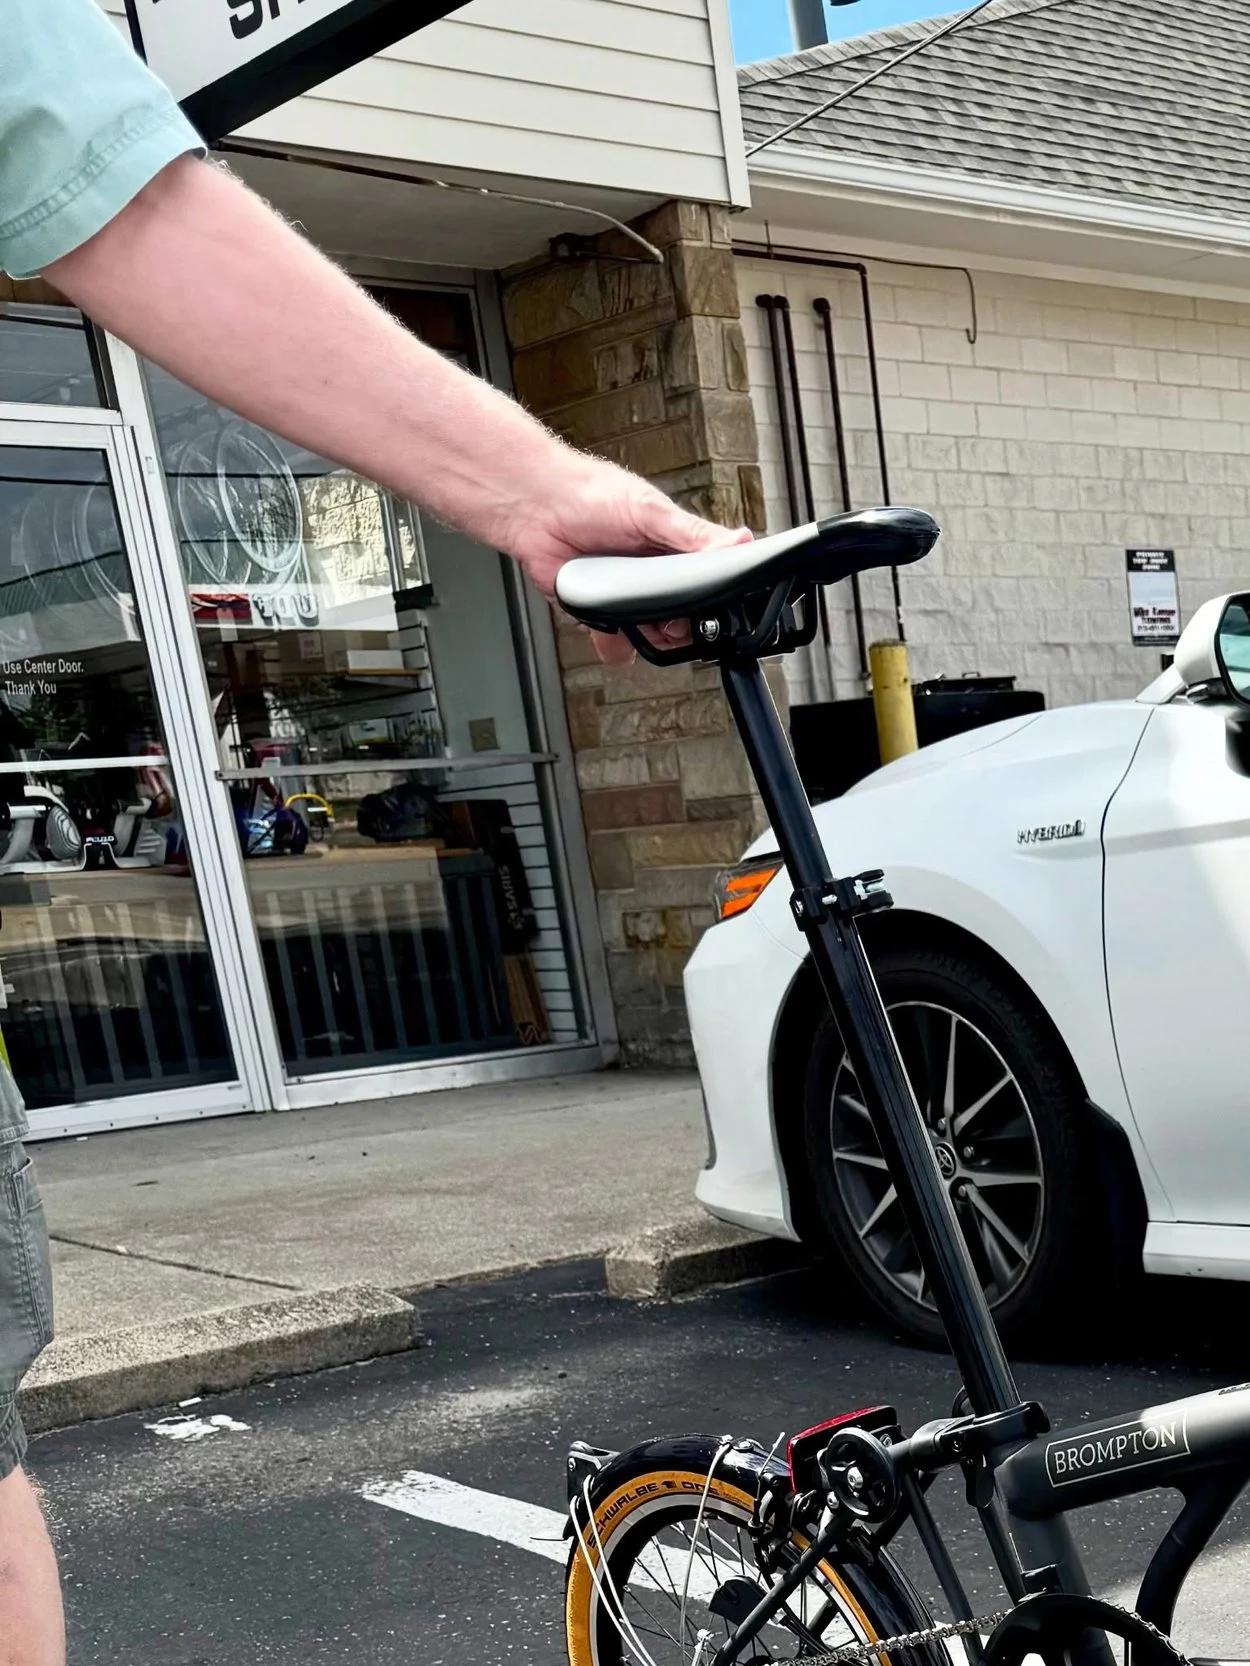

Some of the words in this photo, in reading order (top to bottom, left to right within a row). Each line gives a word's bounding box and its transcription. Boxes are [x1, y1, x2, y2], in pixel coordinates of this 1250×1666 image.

[2, 660, 22, 674] Use
[24, 659, 57, 674] Center
[58, 658, 84, 673] Door.
[5, 680, 36, 695] Thank
[37, 680, 57, 694] You
[499, 865, 518, 910] SARIS
[1054, 1421, 1177, 1474] BROMPTON
